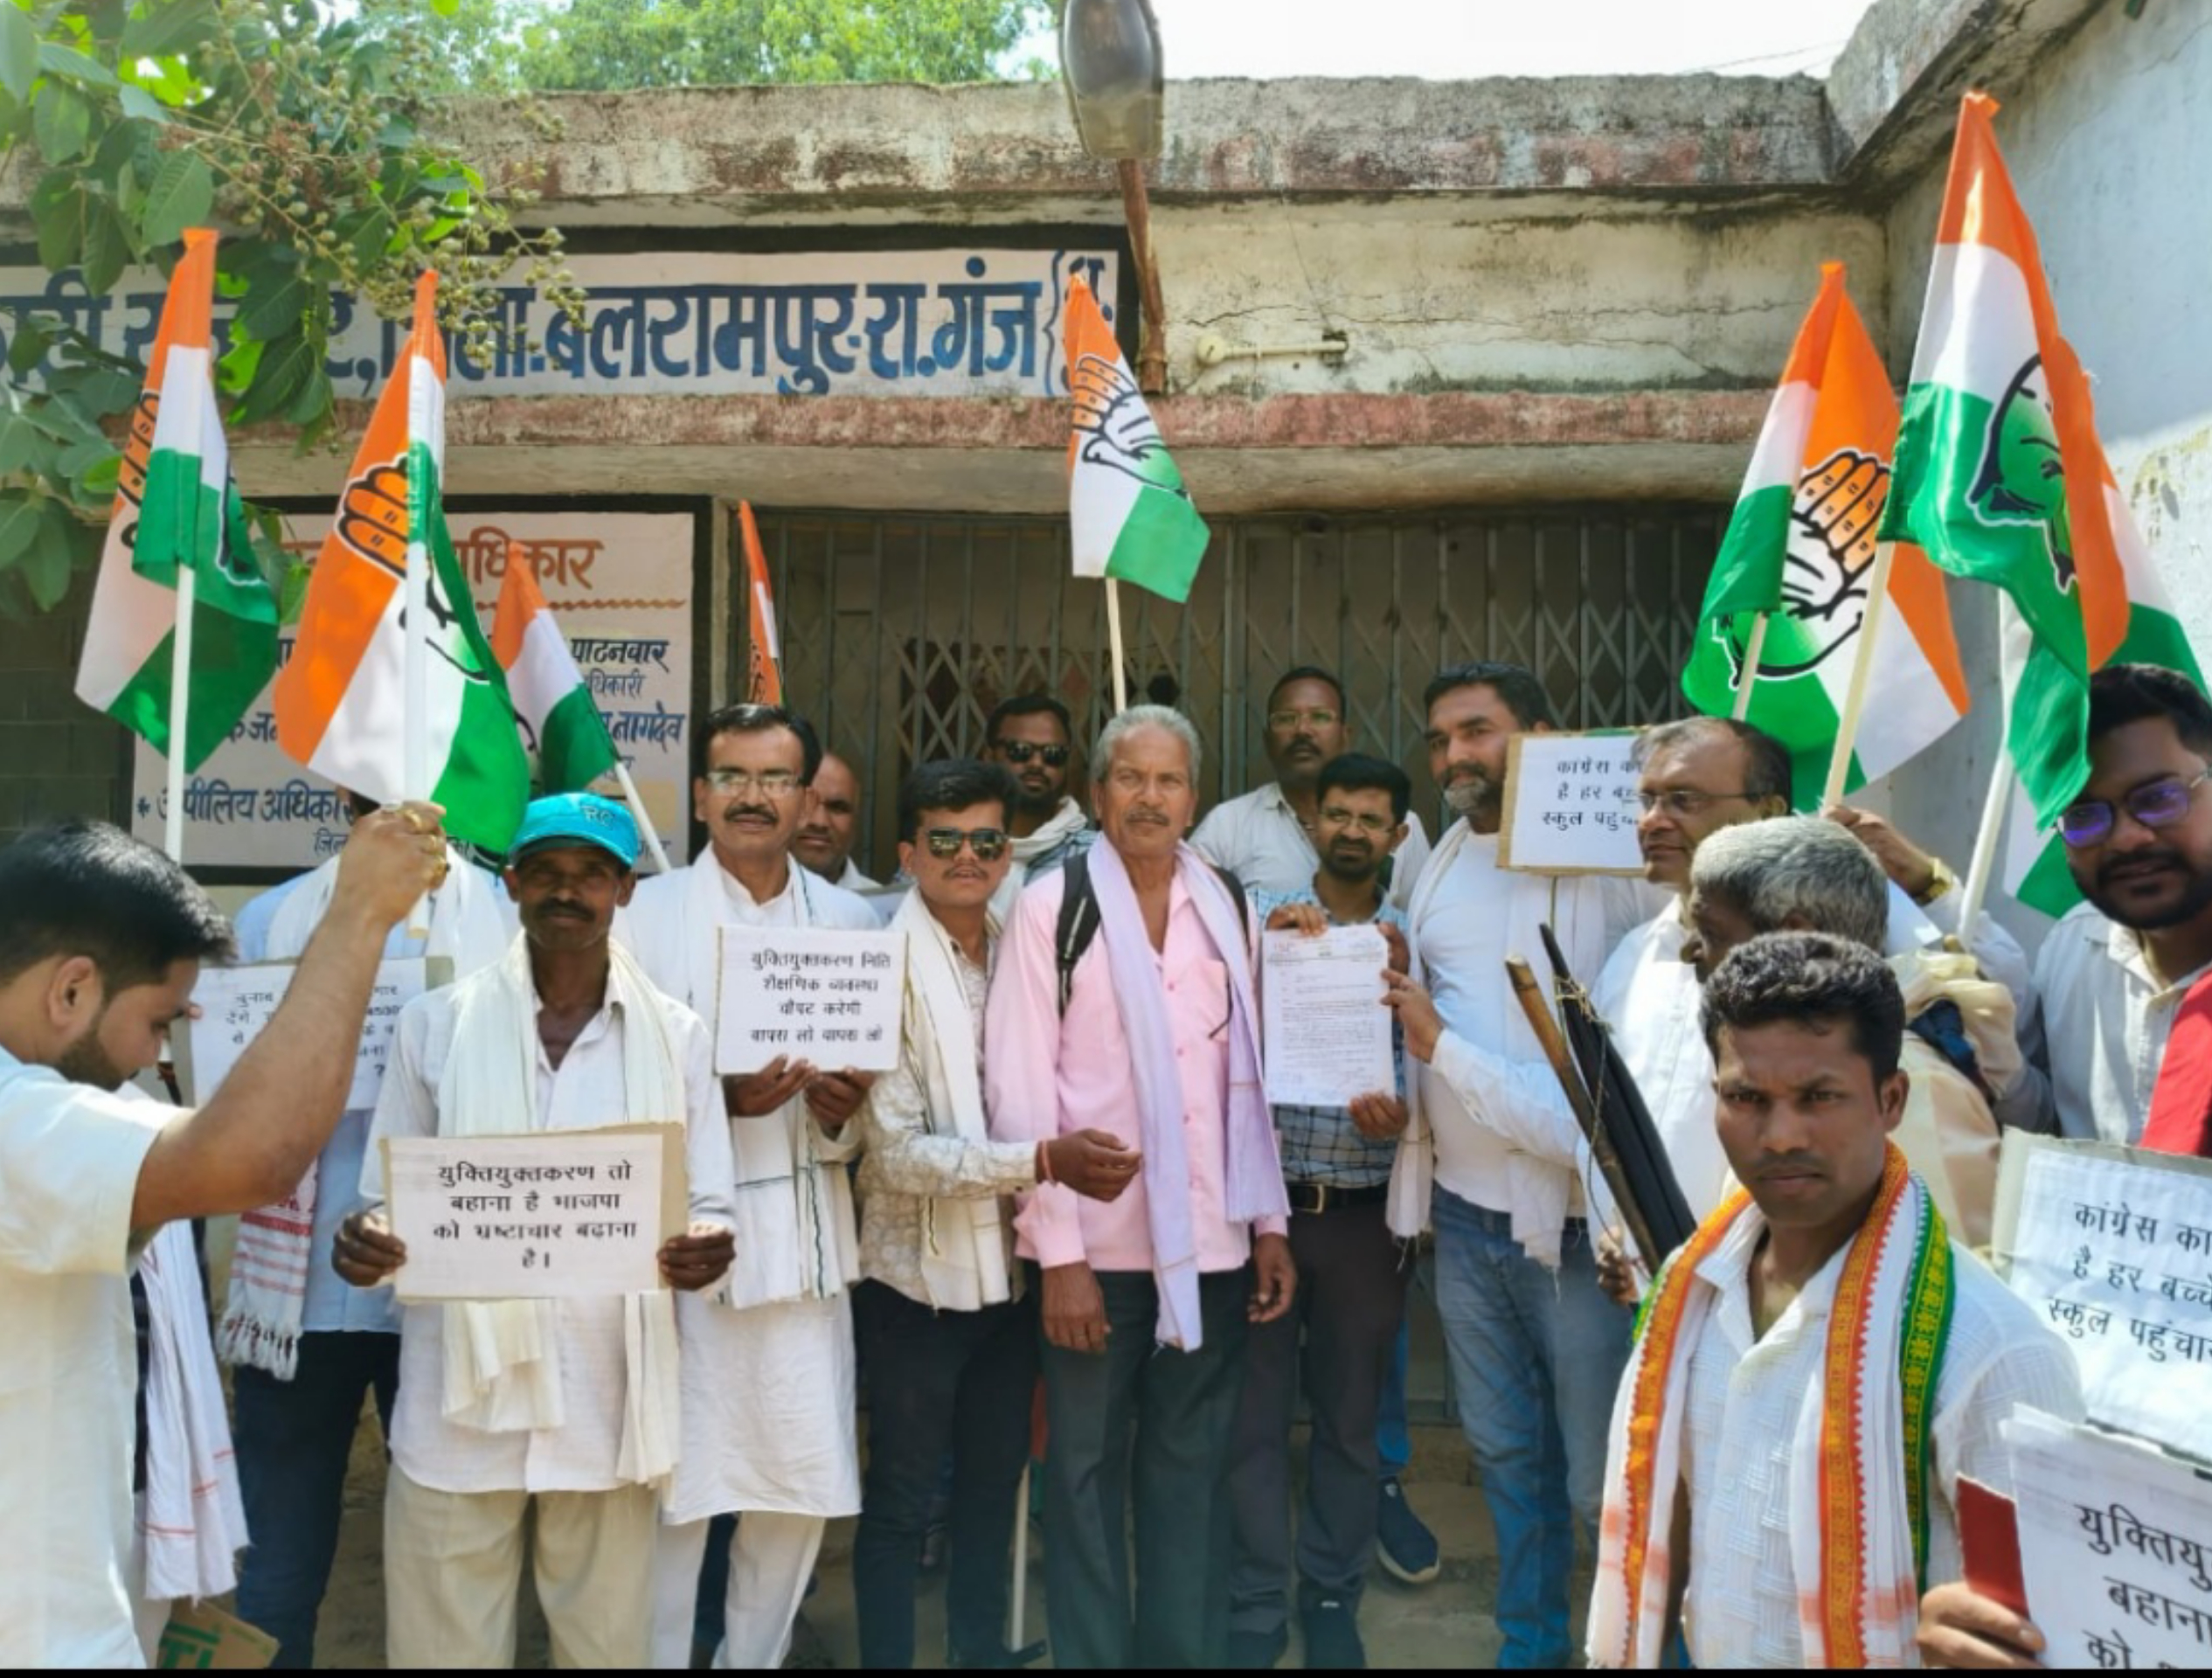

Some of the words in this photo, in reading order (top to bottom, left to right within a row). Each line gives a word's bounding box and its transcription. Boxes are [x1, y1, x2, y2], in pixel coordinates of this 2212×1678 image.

[438, 1161, 595, 1189] युक्तियुक्तकरण
[607, 1160, 633, 1181] तो
[449, 1195, 512, 1212] बहाना
[524, 1189, 540, 1212] है
[552, 1193, 621, 1210] भाजपा
[433, 1219, 460, 1239] को
[2074, 1201, 2160, 1244] कांग्रेस
[2072, 1245, 2092, 1279] है
[2107, 1259, 2143, 1293] हर
[2129, 1317, 2212, 1363] पहुंचा
[2072, 1501, 2212, 1592] युक्तियु
